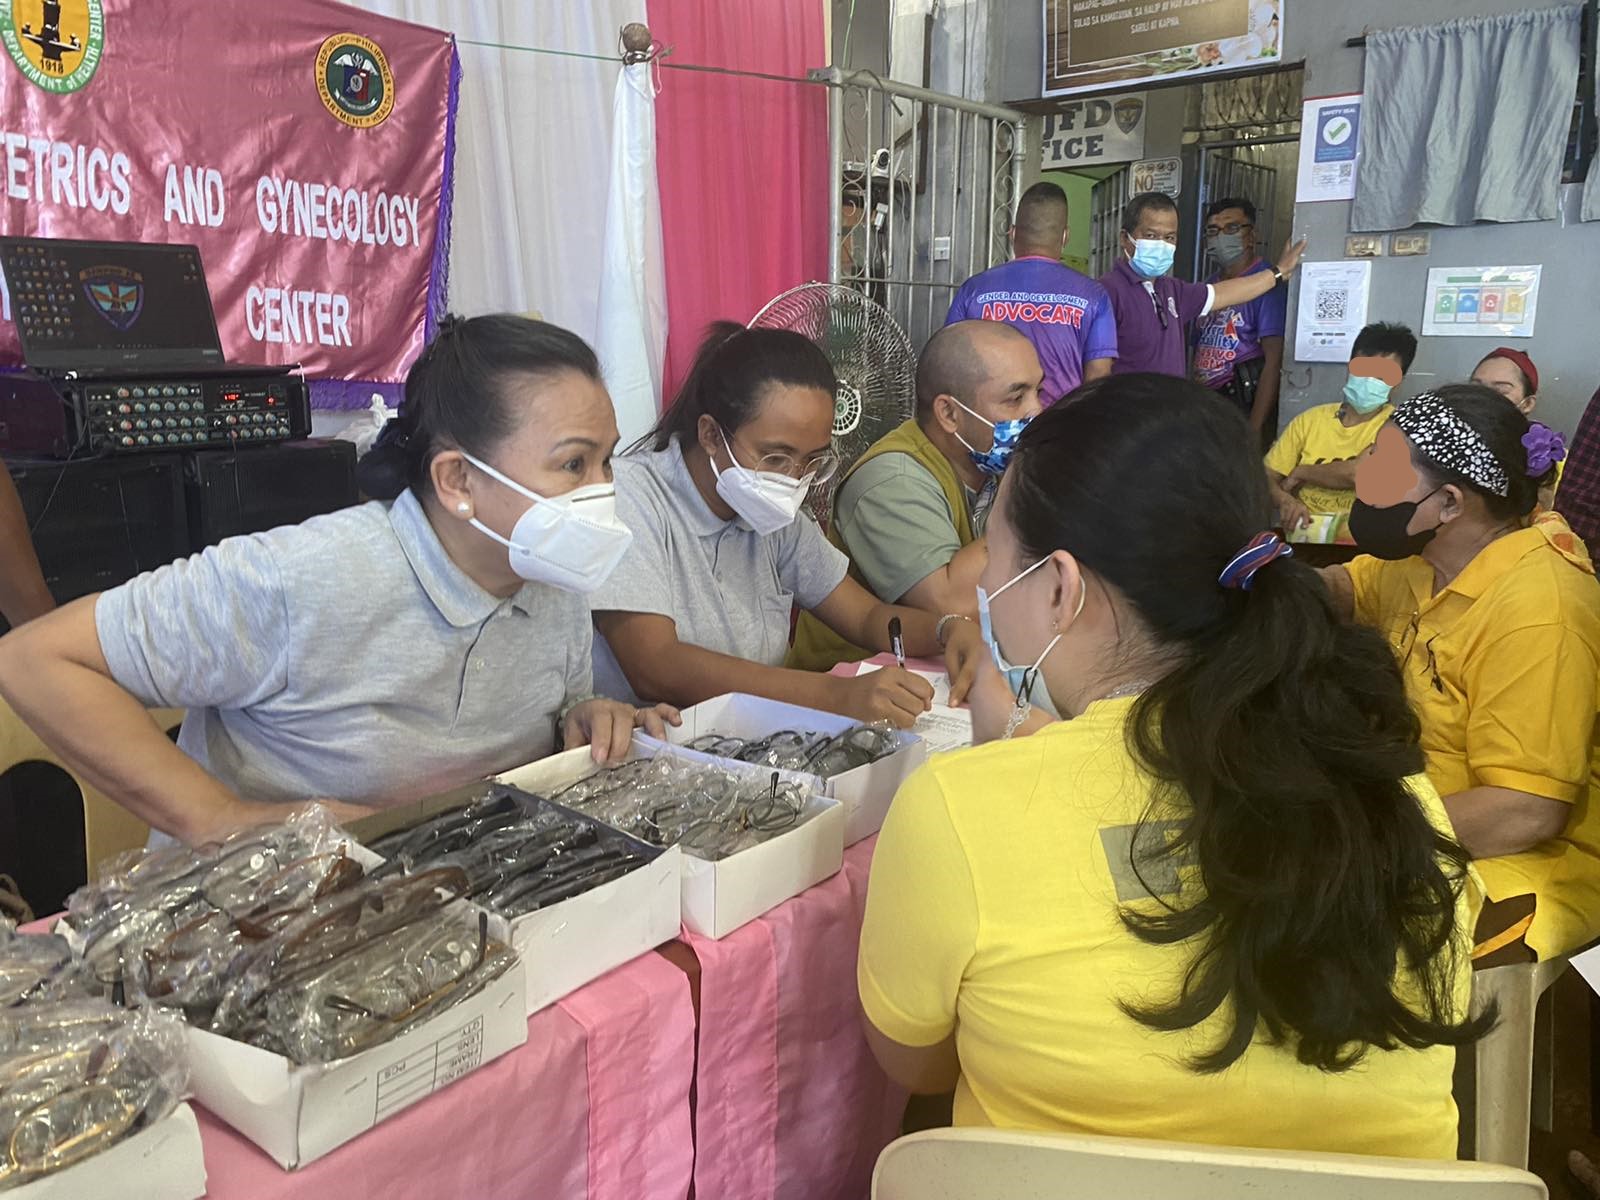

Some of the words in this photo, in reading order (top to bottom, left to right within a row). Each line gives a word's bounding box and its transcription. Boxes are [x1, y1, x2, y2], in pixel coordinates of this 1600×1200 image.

[319, 78, 363, 124] DEPARTMENT
[163, 163, 225, 228] AND
[256, 175, 420, 247] GYNECOLOGY
[245, 285, 353, 348] CENTER
[977, 291, 1010, 303] GENDER
[1011, 292, 1030, 301] AND
[1030, 293, 1088, 308] DEVELOPMENT
